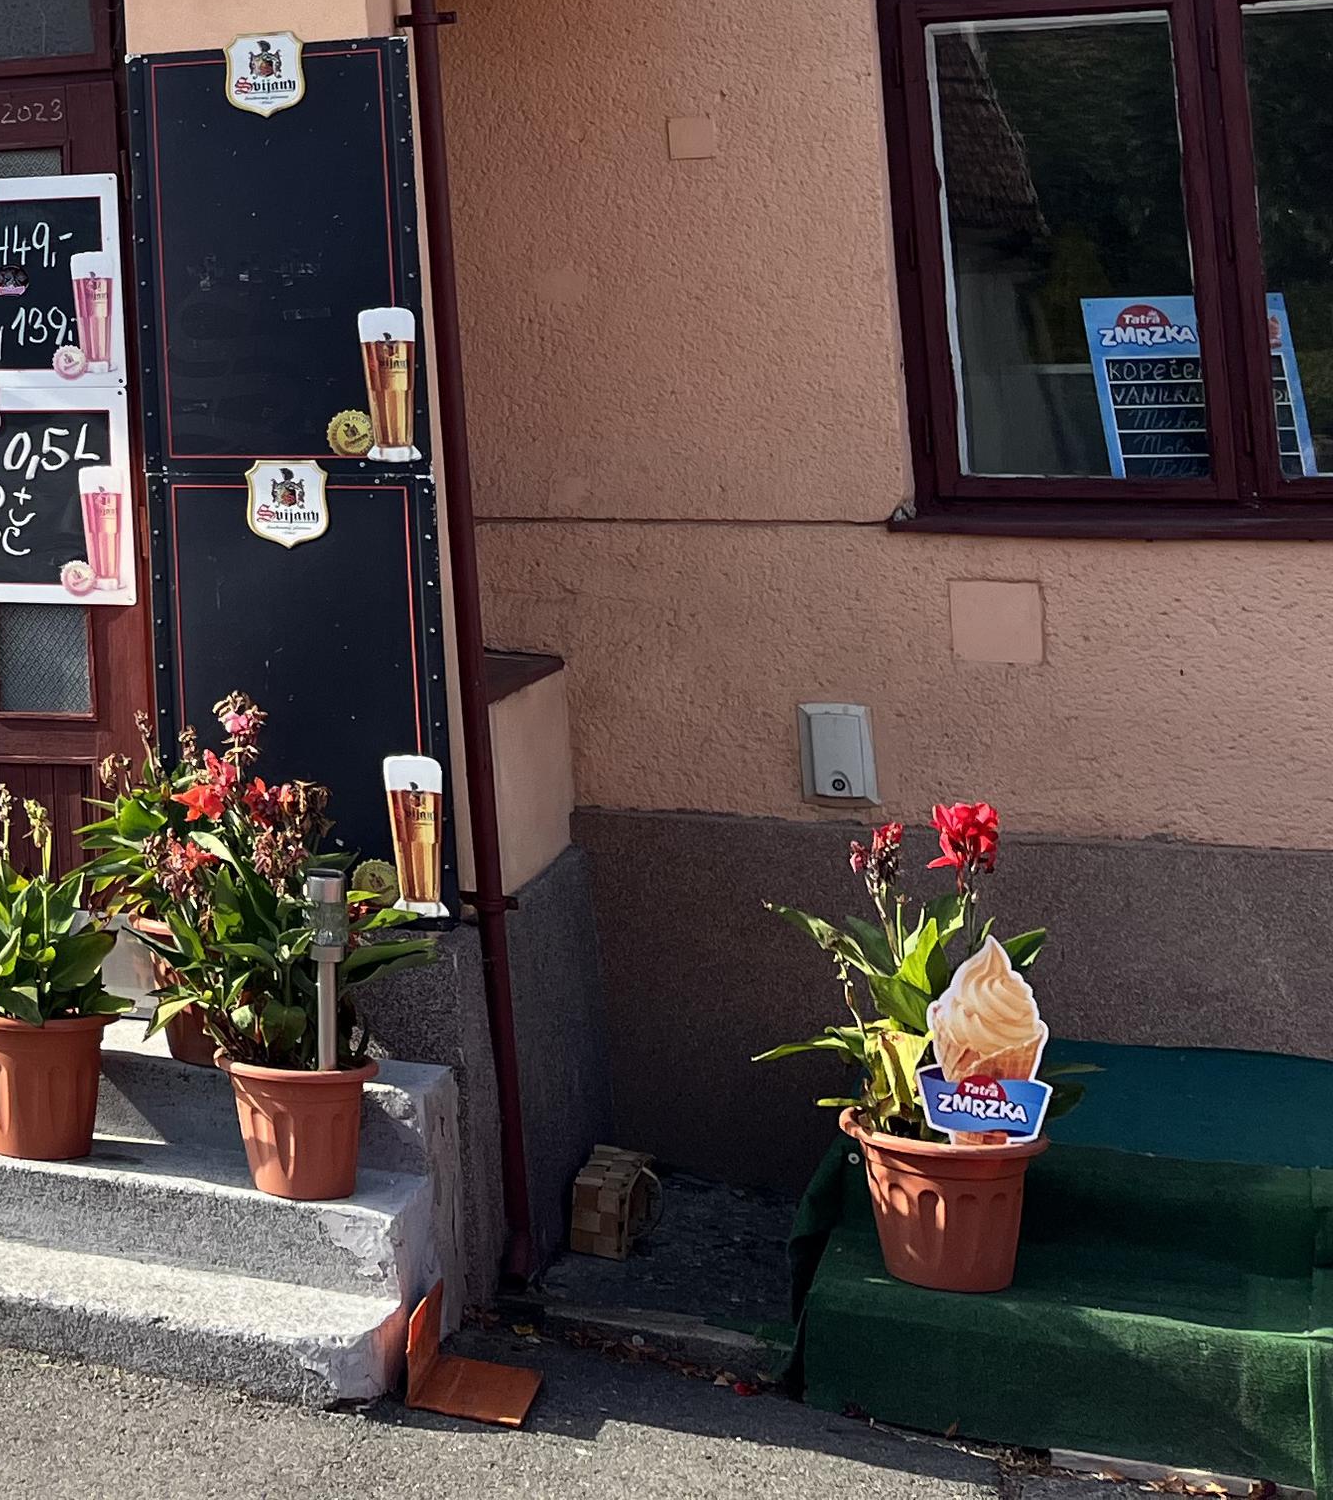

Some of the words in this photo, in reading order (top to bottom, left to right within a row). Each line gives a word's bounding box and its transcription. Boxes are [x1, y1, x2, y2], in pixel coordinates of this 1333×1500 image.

[235, 77, 296, 94] Svijany
[1099, 325, 1196, 347] ZMRZKA
[257, 504, 319, 523] Svijany
[937, 1094, 1028, 1123] ZMRZKA
